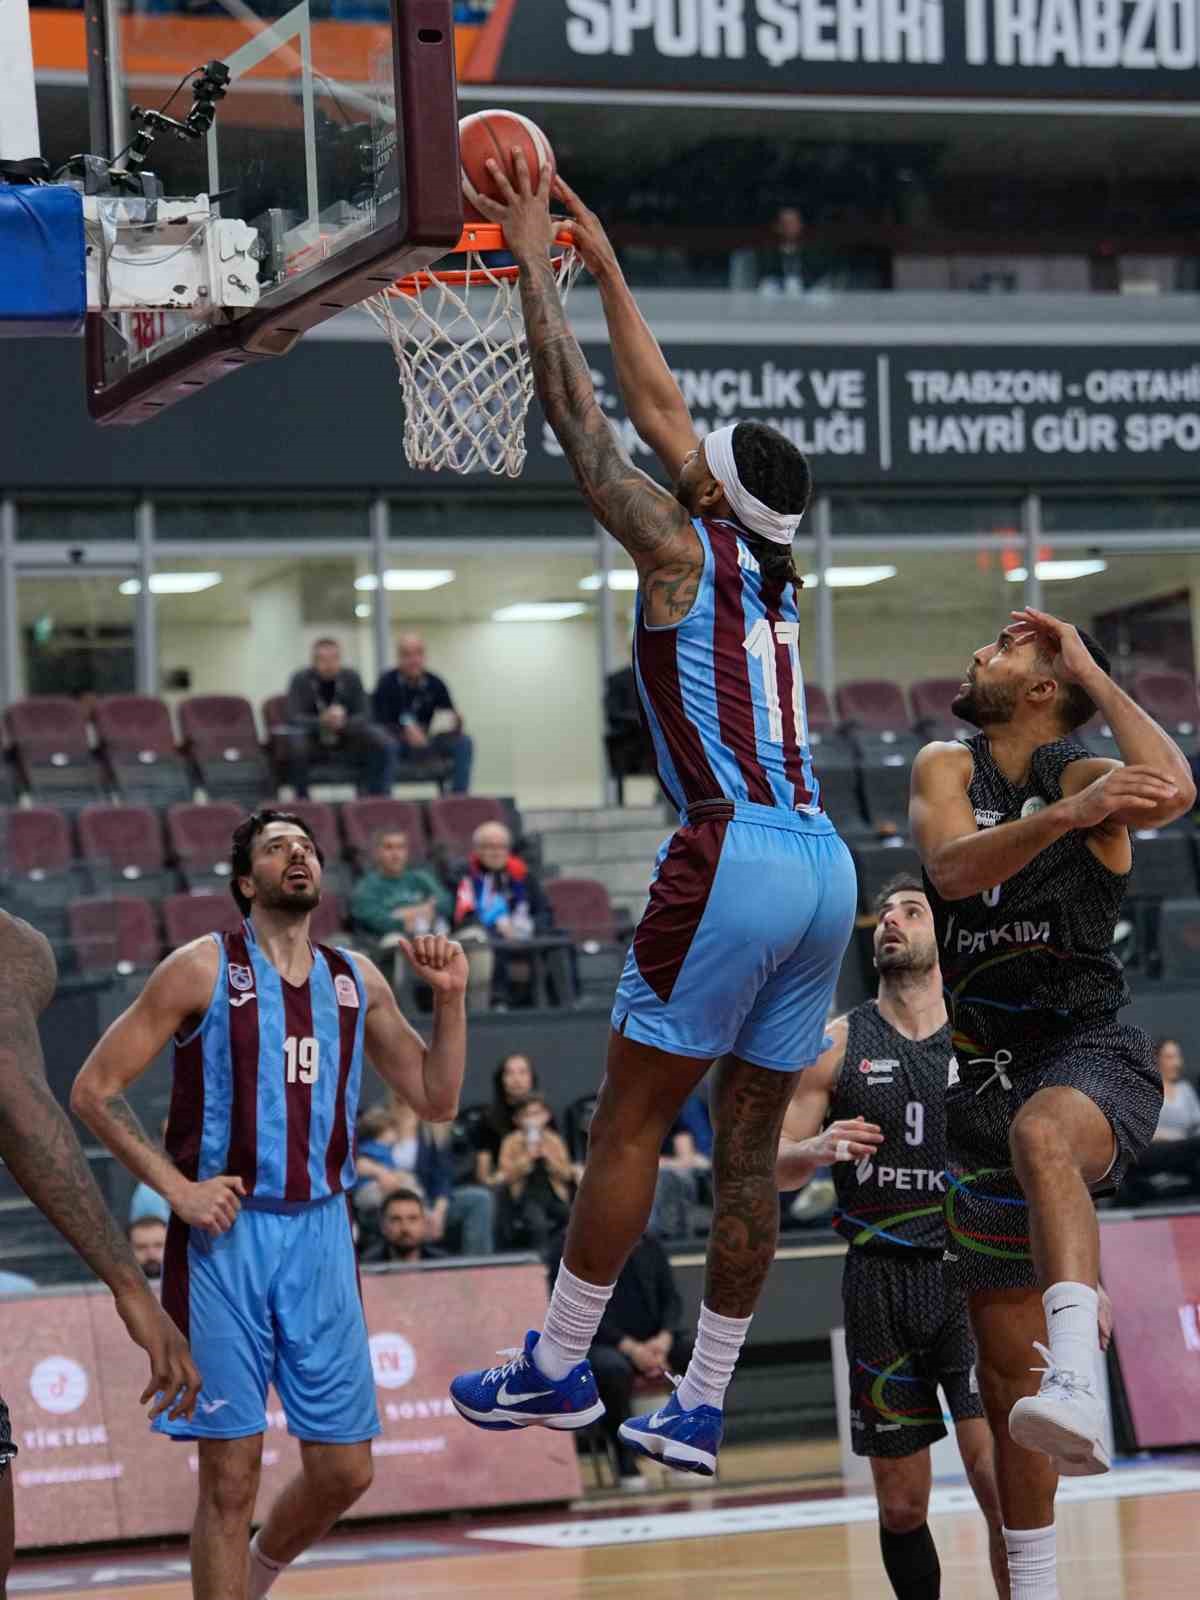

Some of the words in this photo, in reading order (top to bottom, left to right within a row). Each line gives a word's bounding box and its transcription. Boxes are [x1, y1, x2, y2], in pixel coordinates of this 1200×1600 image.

[566, 0, 747, 59] SPOR
[964, 0, 1200, 70] TRABZO
[673, 362, 805, 417] NÇLİK
[808, 369, 866, 409] VE
[906, 369, 1063, 404] TRABZON
[909, 406, 1025, 454] HAYRİ
[1032, 407, 1119, 454] GÜR
[742, 618, 807, 747] 17
[282, 1036, 320, 1085] 19
[905, 1101, 925, 1146] 9
[877, 1166, 946, 1193] PETK
